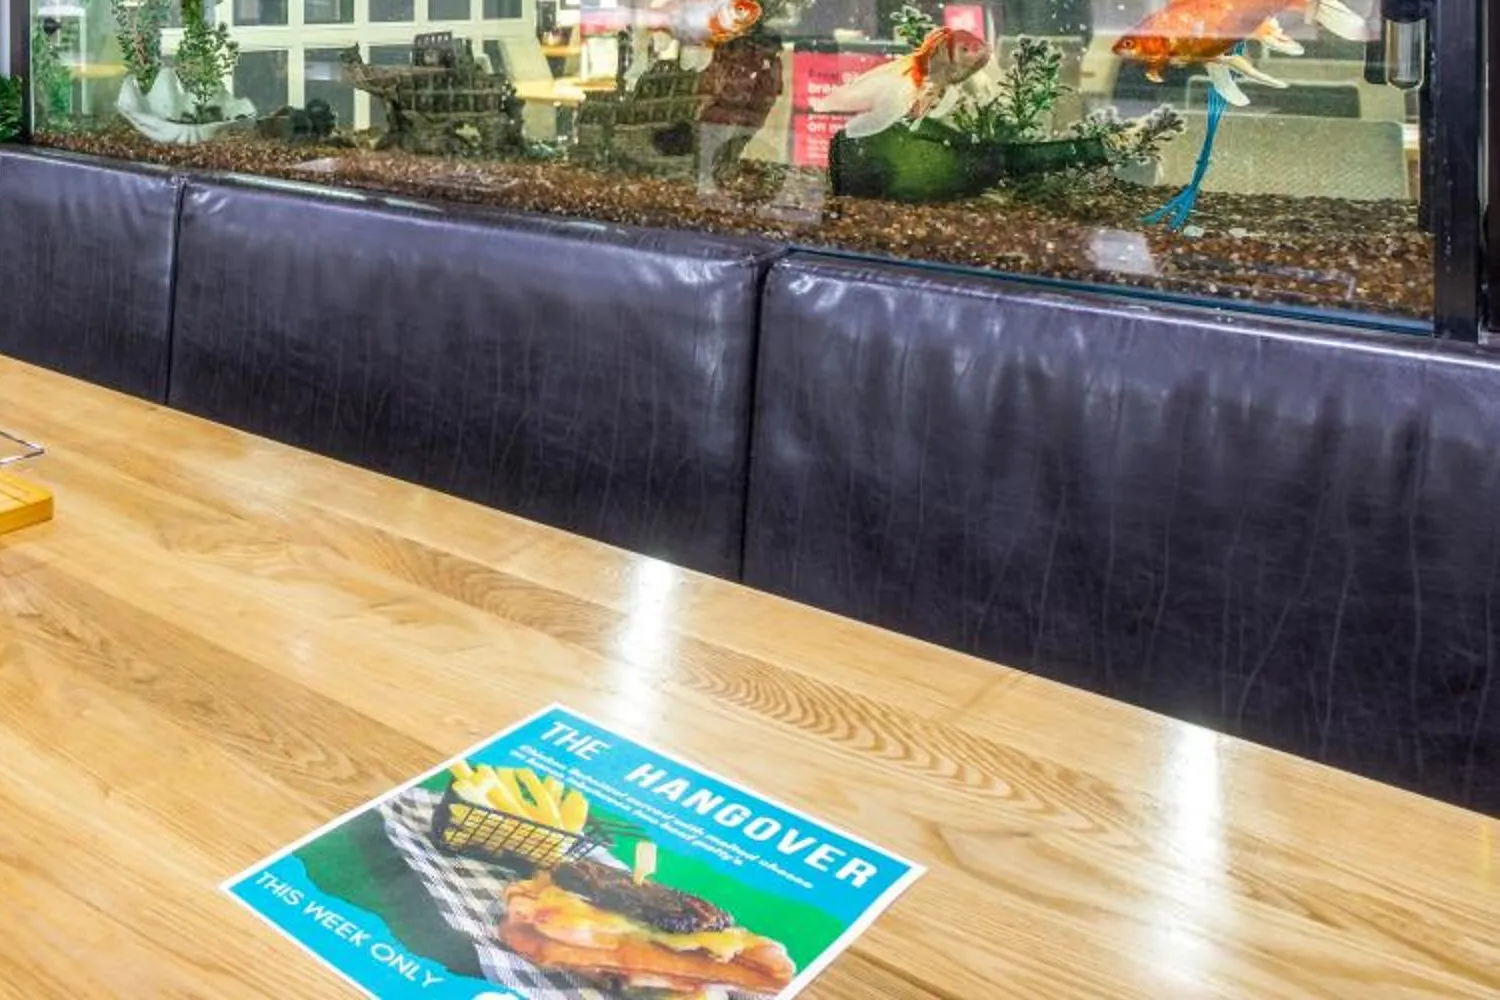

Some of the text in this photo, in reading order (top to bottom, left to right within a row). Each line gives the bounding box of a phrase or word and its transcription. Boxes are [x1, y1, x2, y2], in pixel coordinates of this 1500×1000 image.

[539, 721, 877, 889] THE HANGOVER
[256, 871, 444, 988] THIS WEEK ONLY
